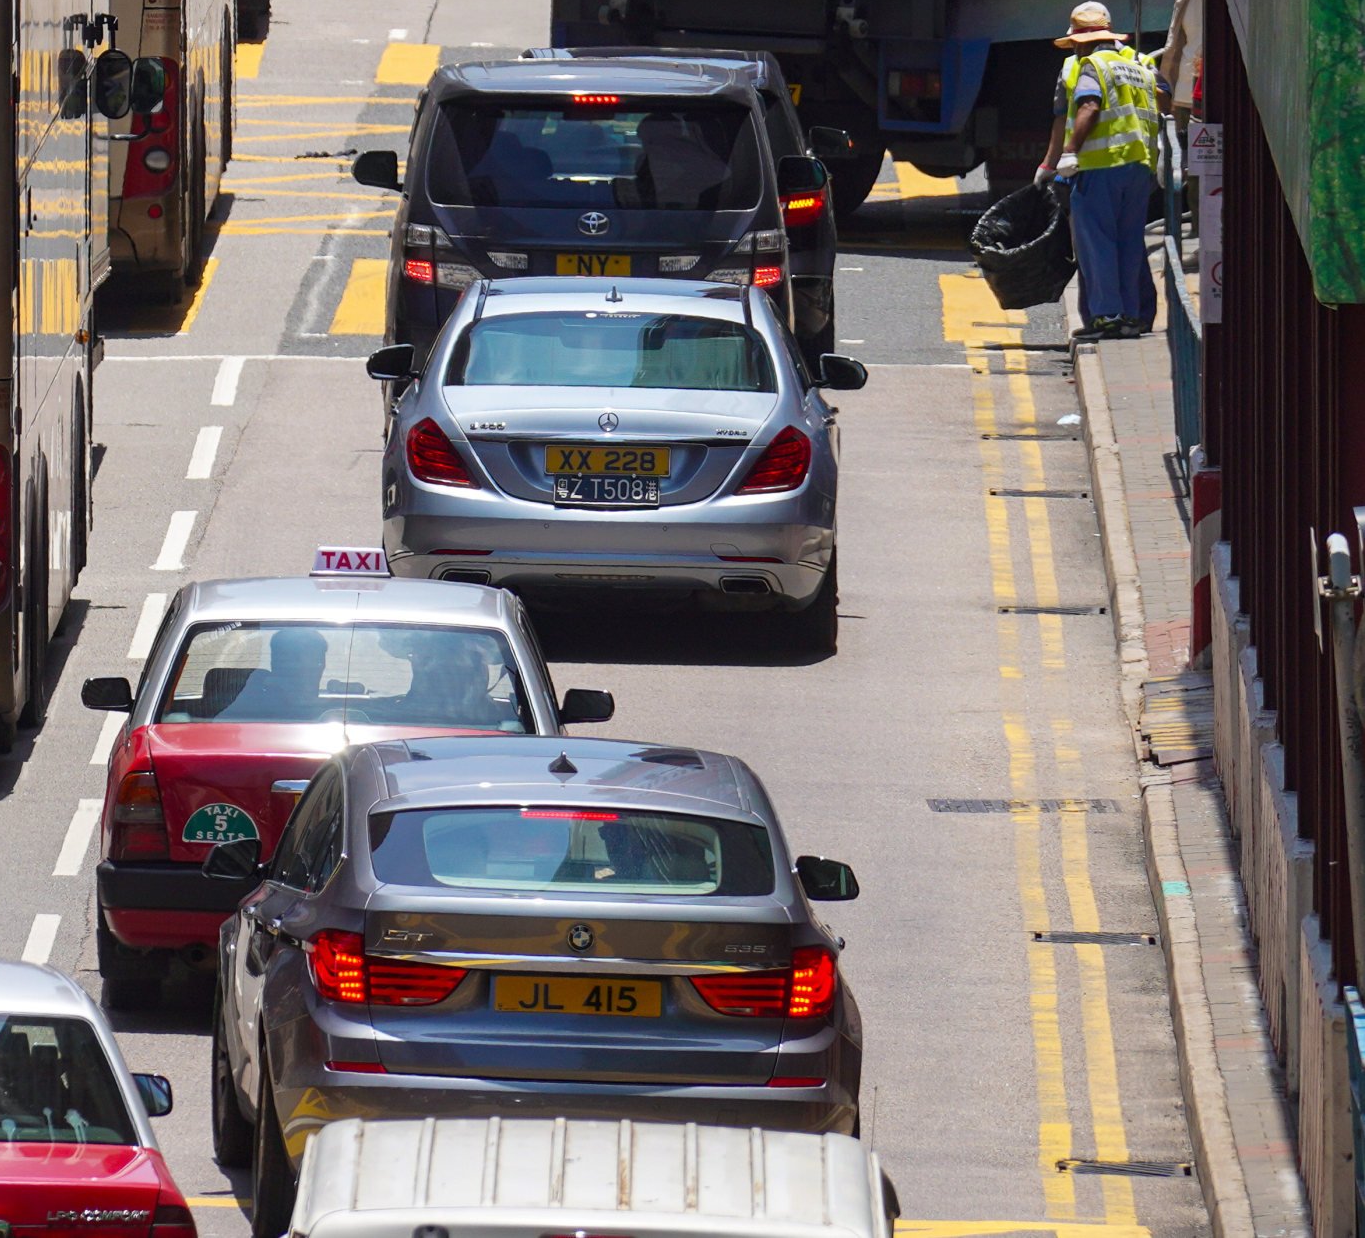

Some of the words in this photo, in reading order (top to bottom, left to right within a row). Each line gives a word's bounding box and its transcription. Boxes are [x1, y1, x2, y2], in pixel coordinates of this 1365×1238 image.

[577, 254, 611, 276] NY
[559, 449, 593, 471] XX
[603, 451, 656, 473] 228
[321, 551, 381, 571] TAXI
[203, 805, 240, 819] TAXI
[214, 815, 228, 832] 5
[195, 829, 246, 841] SEATS
[517, 982, 564, 1010] JL
[582, 984, 638, 1015] 415
